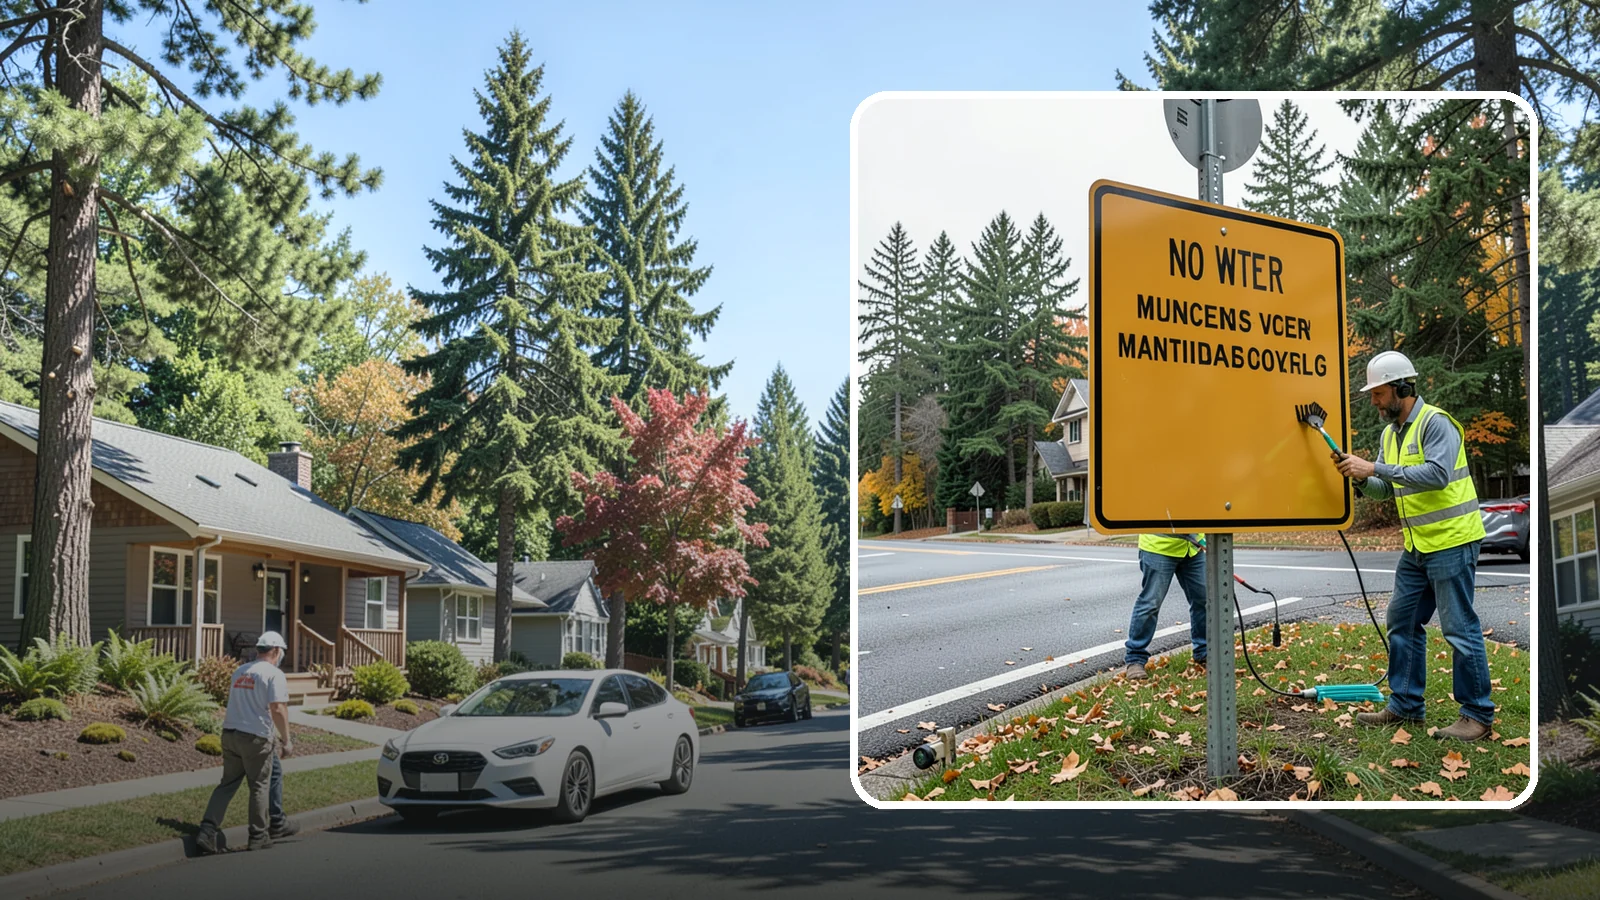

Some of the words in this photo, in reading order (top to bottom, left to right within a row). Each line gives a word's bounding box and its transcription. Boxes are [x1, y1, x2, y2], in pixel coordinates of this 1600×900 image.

[1169, 238, 1204, 281] NO
[1215, 245, 1284, 294] WTER
[1137, 294, 1252, 333] MUNCENS
